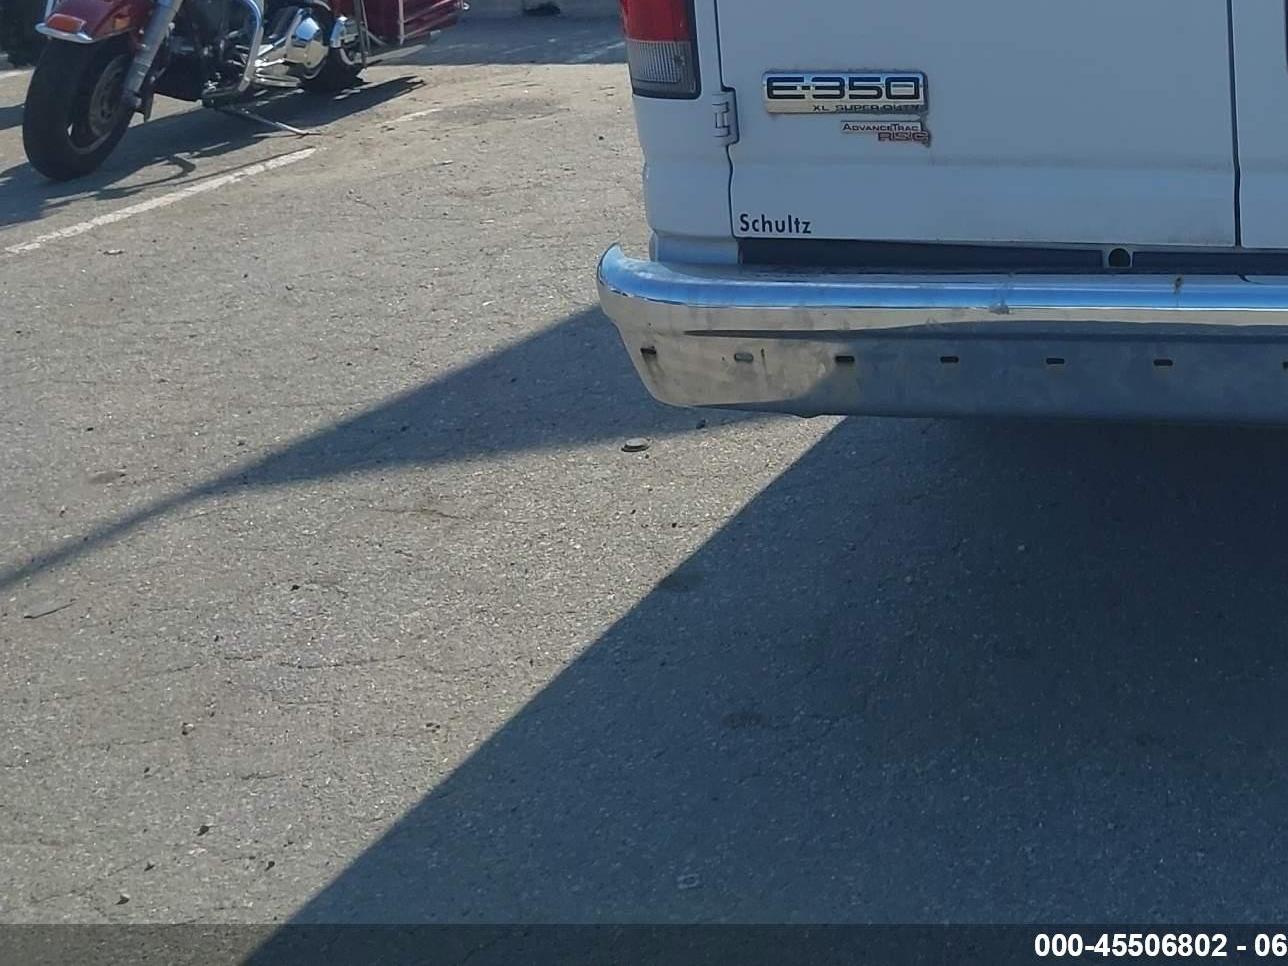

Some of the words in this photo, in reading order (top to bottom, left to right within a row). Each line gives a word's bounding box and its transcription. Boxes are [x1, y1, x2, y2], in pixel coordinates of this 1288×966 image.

[766, 76, 921, 100] E-350
[812, 104, 830, 112] XL
[834, 104, 880, 113] SUPER
[740, 213, 812, 234] Schultz
